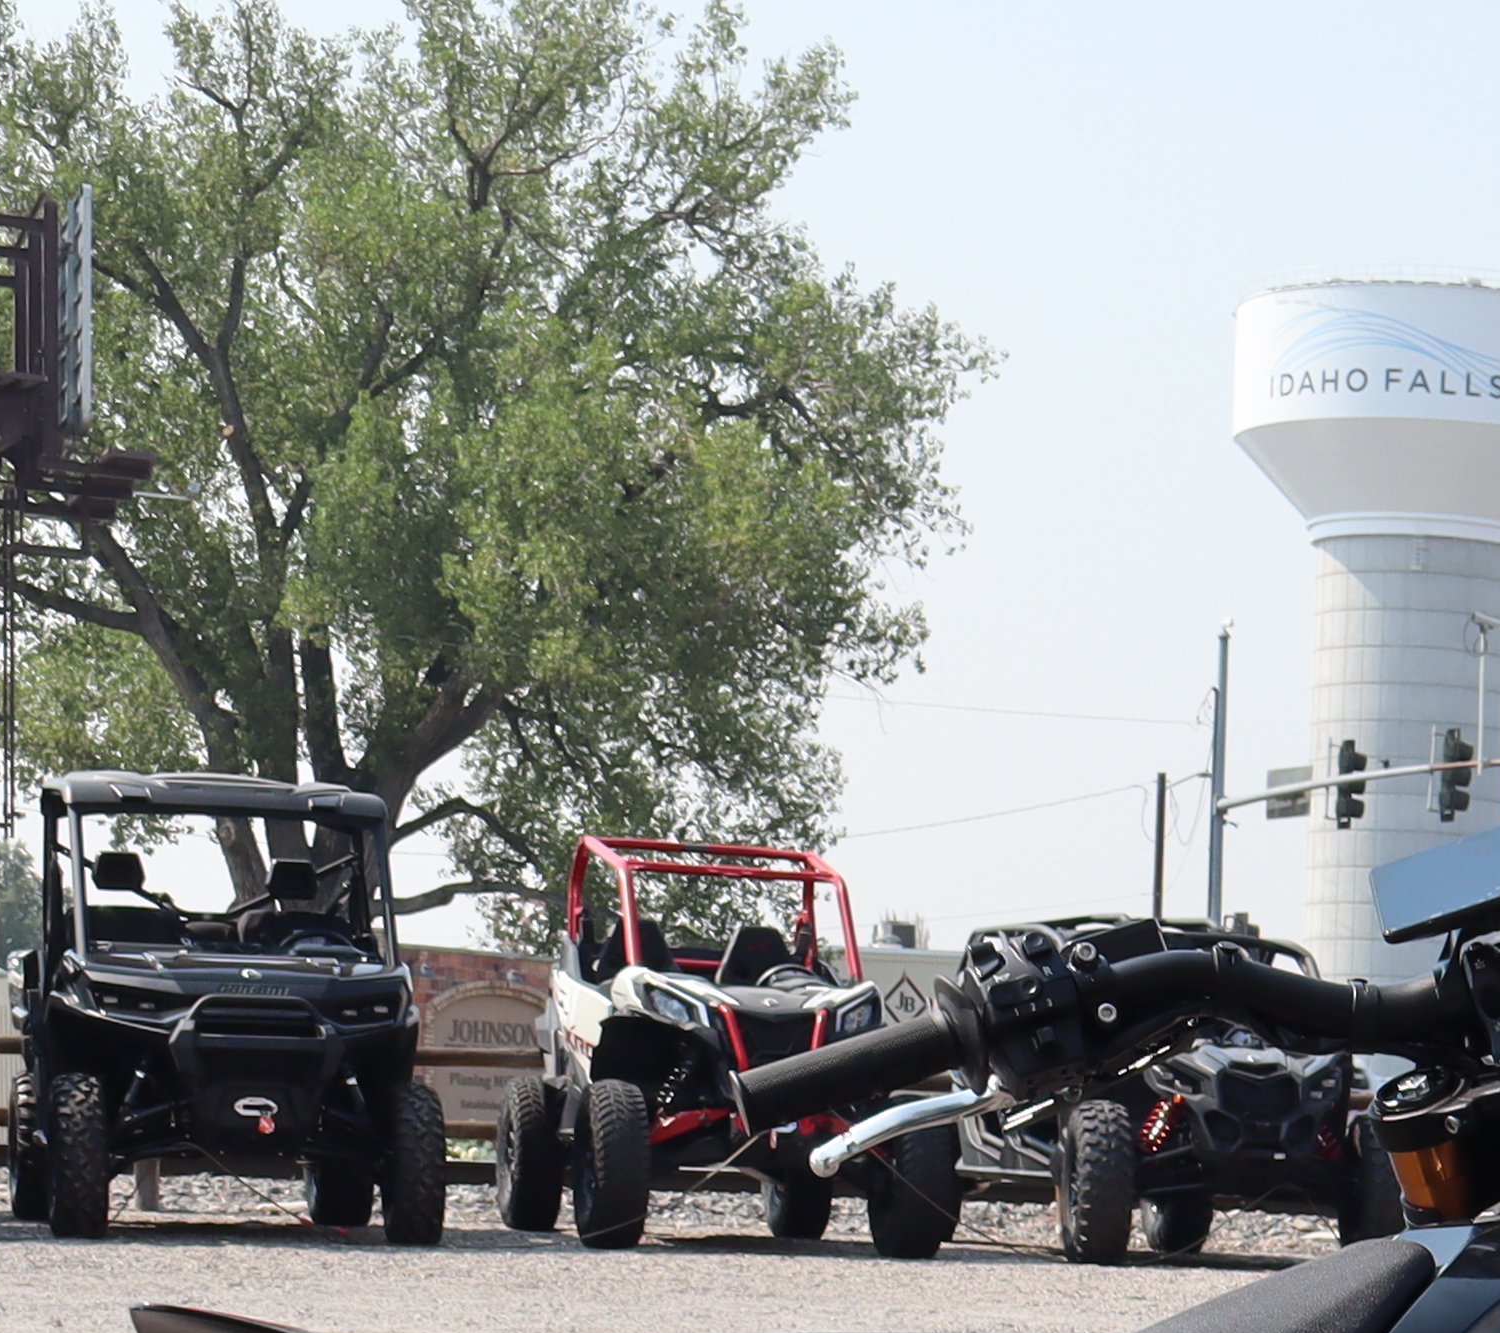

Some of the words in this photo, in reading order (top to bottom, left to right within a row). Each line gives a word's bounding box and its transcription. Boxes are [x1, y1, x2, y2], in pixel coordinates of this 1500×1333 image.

[1269, 368, 1369, 399] IDAHO
[1042, 965, 1053, 977] R
[894, 990, 915, 1013] JB
[448, 1018, 539, 1047] JOHNSON
